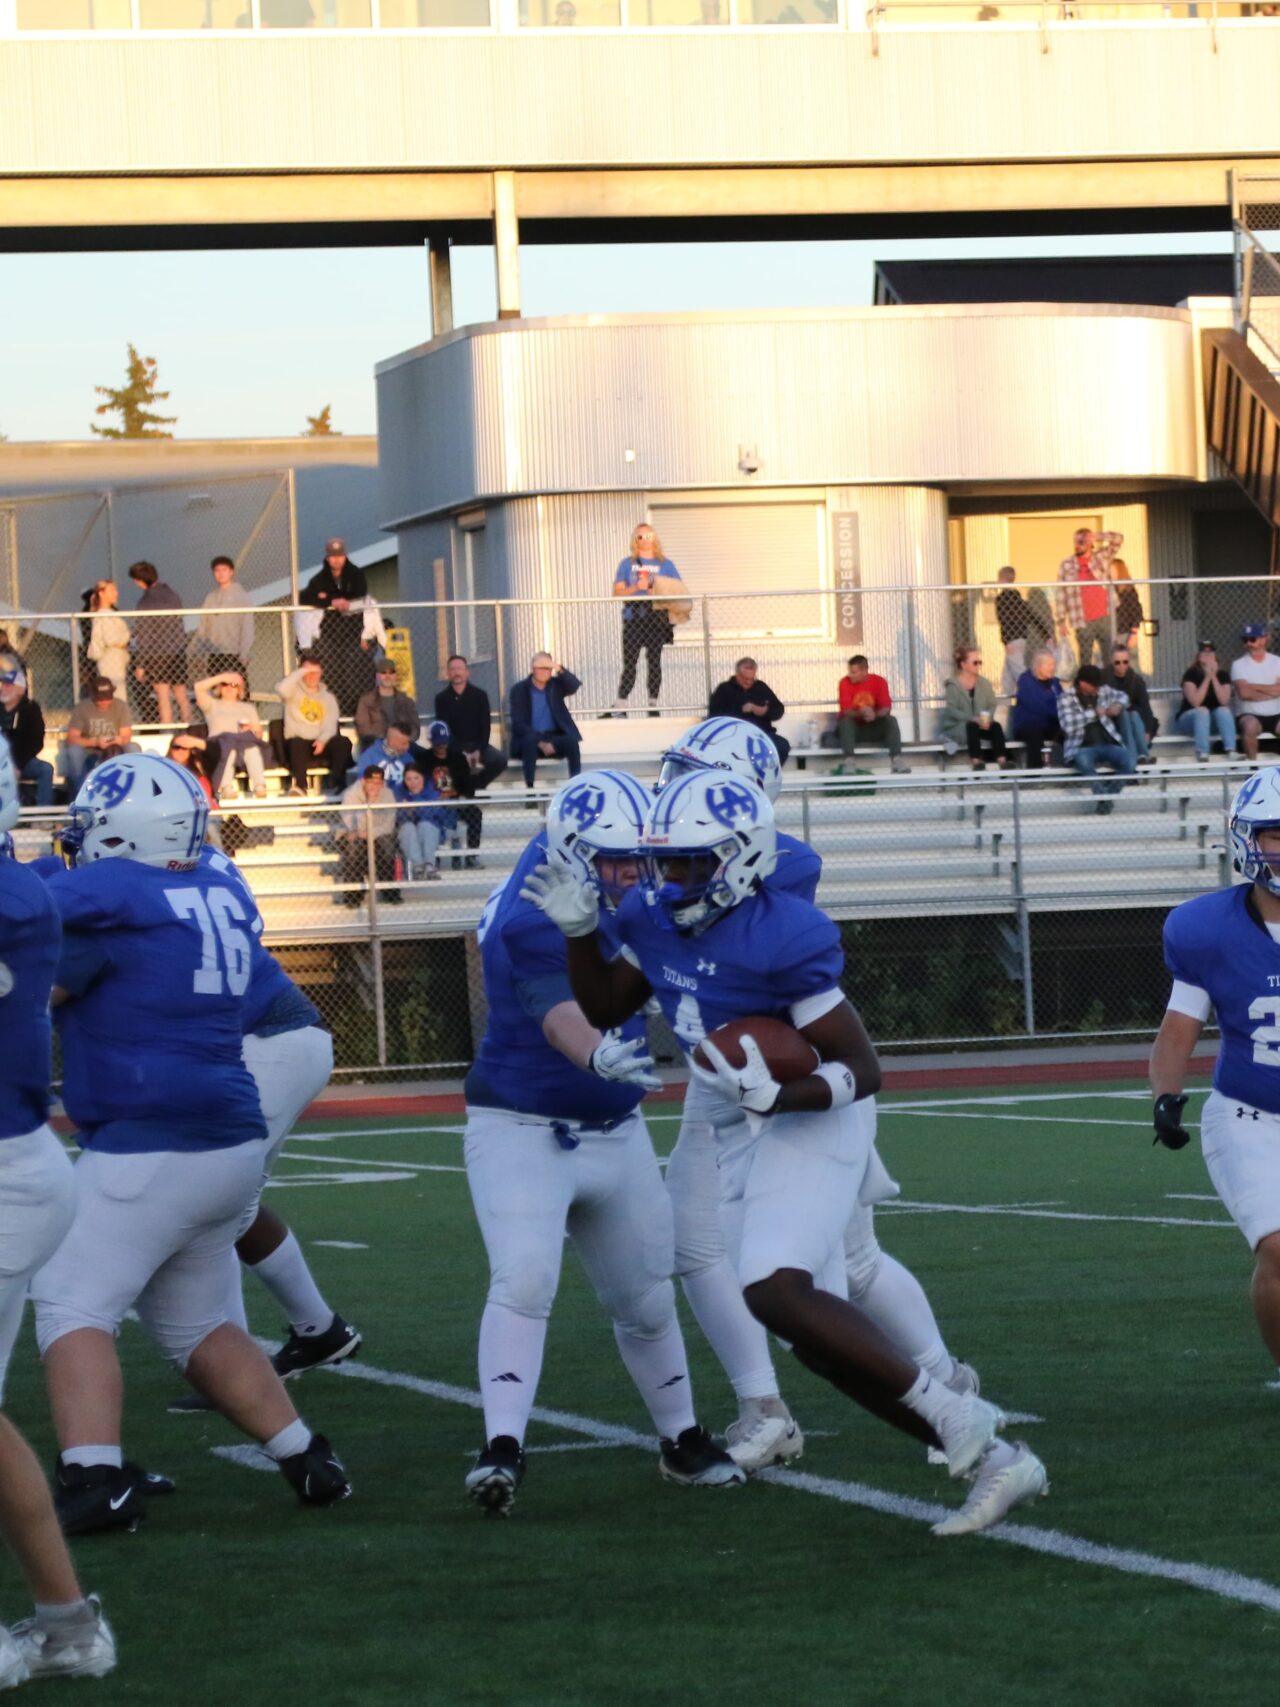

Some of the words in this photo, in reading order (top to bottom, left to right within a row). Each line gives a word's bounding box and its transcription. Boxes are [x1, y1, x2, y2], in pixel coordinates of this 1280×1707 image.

[838, 517, 857, 629] CONCESSION
[163, 886, 251, 996] 76
[662, 966, 698, 991] TITANS
